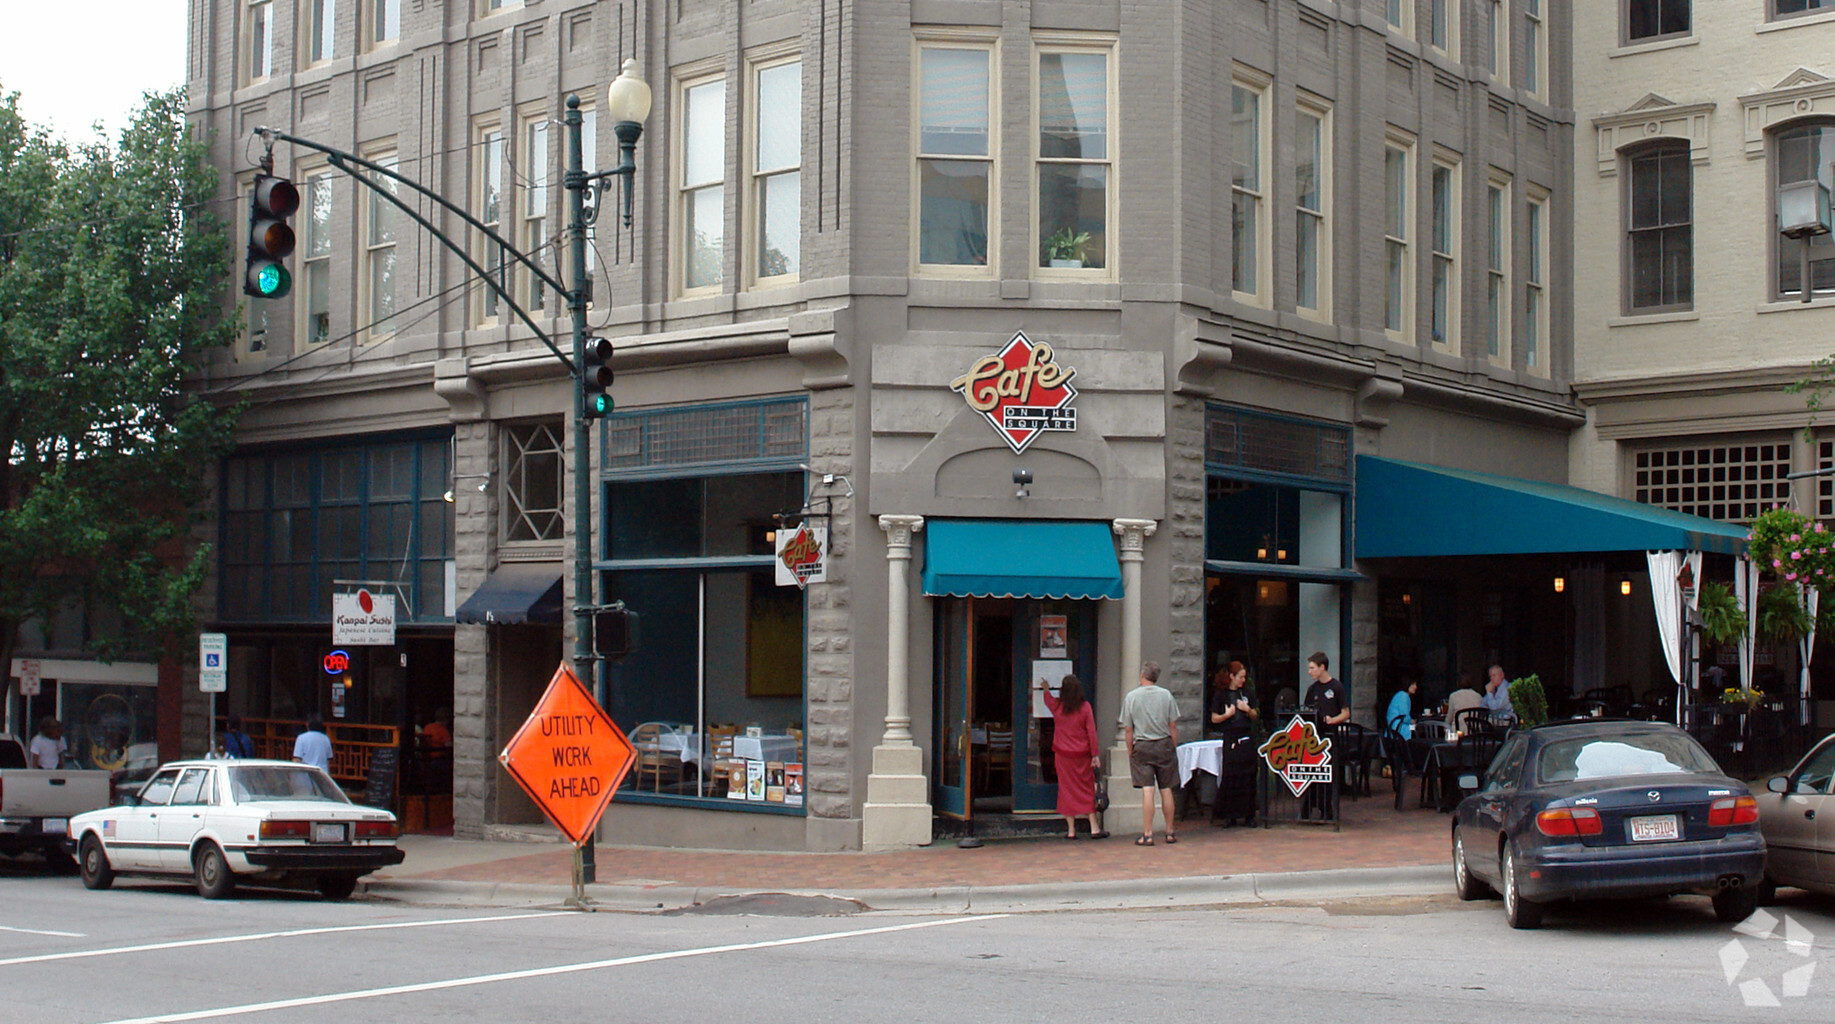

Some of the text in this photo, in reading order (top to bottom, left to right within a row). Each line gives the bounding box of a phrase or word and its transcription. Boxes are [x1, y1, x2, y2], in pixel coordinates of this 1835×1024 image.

[951, 343, 1075, 412] Cafe
[1006, 408, 1071, 417] ON THE
[1007, 419, 1072, 429] SQUARE
[778, 529, 822, 568] Cafe
[369, 614, 392, 625] Sushi
[324, 655, 348, 670] OPEN
[541, 715, 595, 736] UTILITY
[552, 745, 592, 767] WORK
[1260, 723, 1329, 770] Cafe
[549, 776, 600, 798] AHEAD
